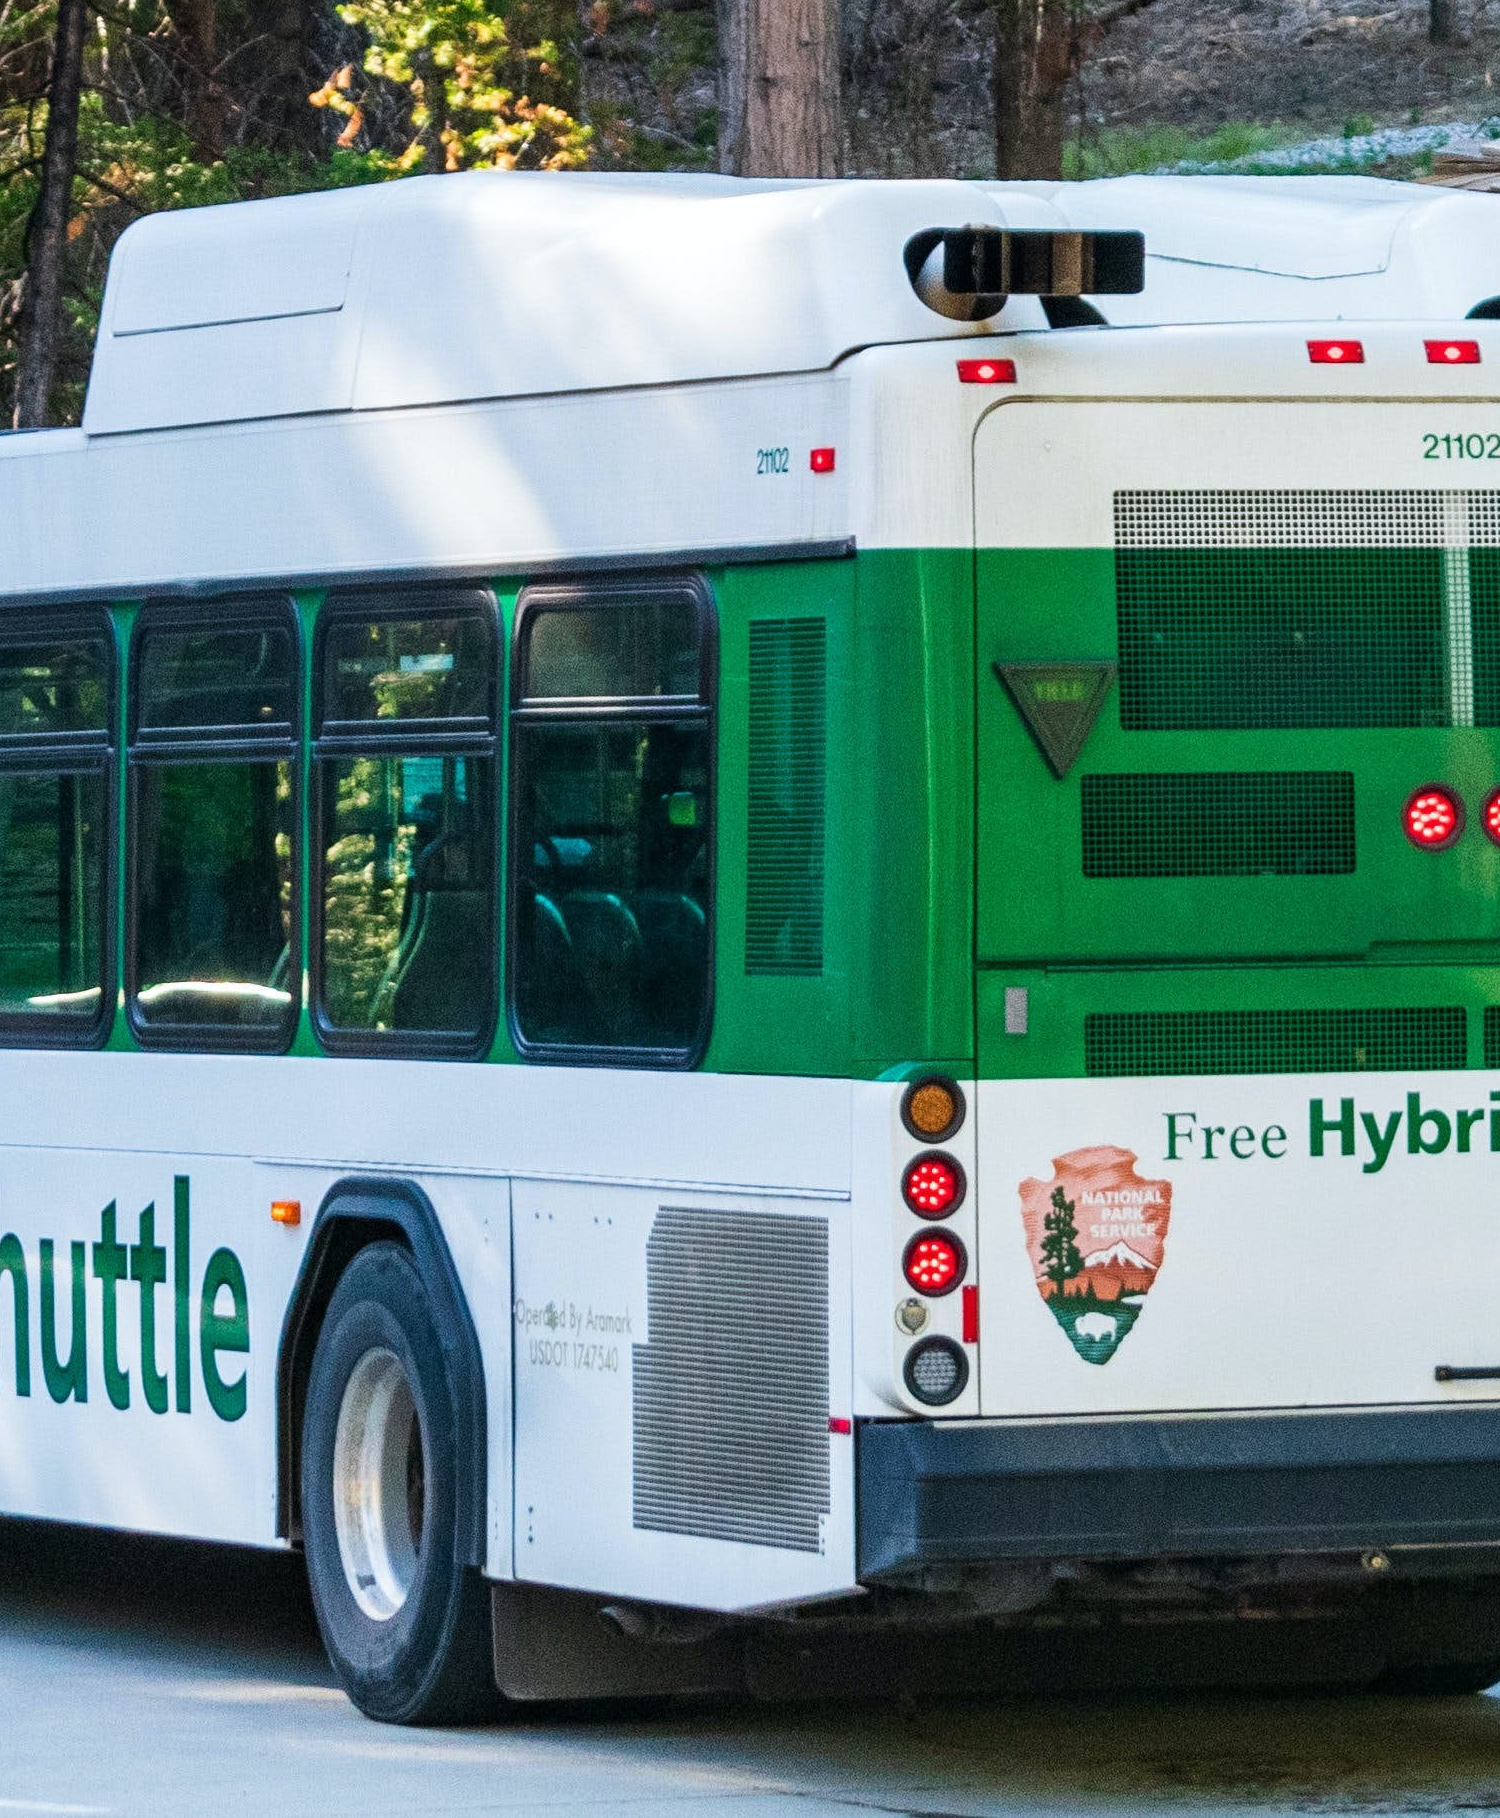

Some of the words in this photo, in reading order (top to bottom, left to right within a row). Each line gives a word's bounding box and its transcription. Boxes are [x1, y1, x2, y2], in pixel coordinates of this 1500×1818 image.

[756, 446, 790, 475] 21102
[1162, 1112, 1288, 1161] Free
[1081, 1188, 1164, 1205] NATIONAL
[1101, 1206, 1144, 1221] PARK
[1090, 1223, 1156, 1238] SERVICE
[570, 1303, 582, 1336] By
[586, 1305, 633, 1334] Aramark
[529, 1338, 568, 1367] USDOT
